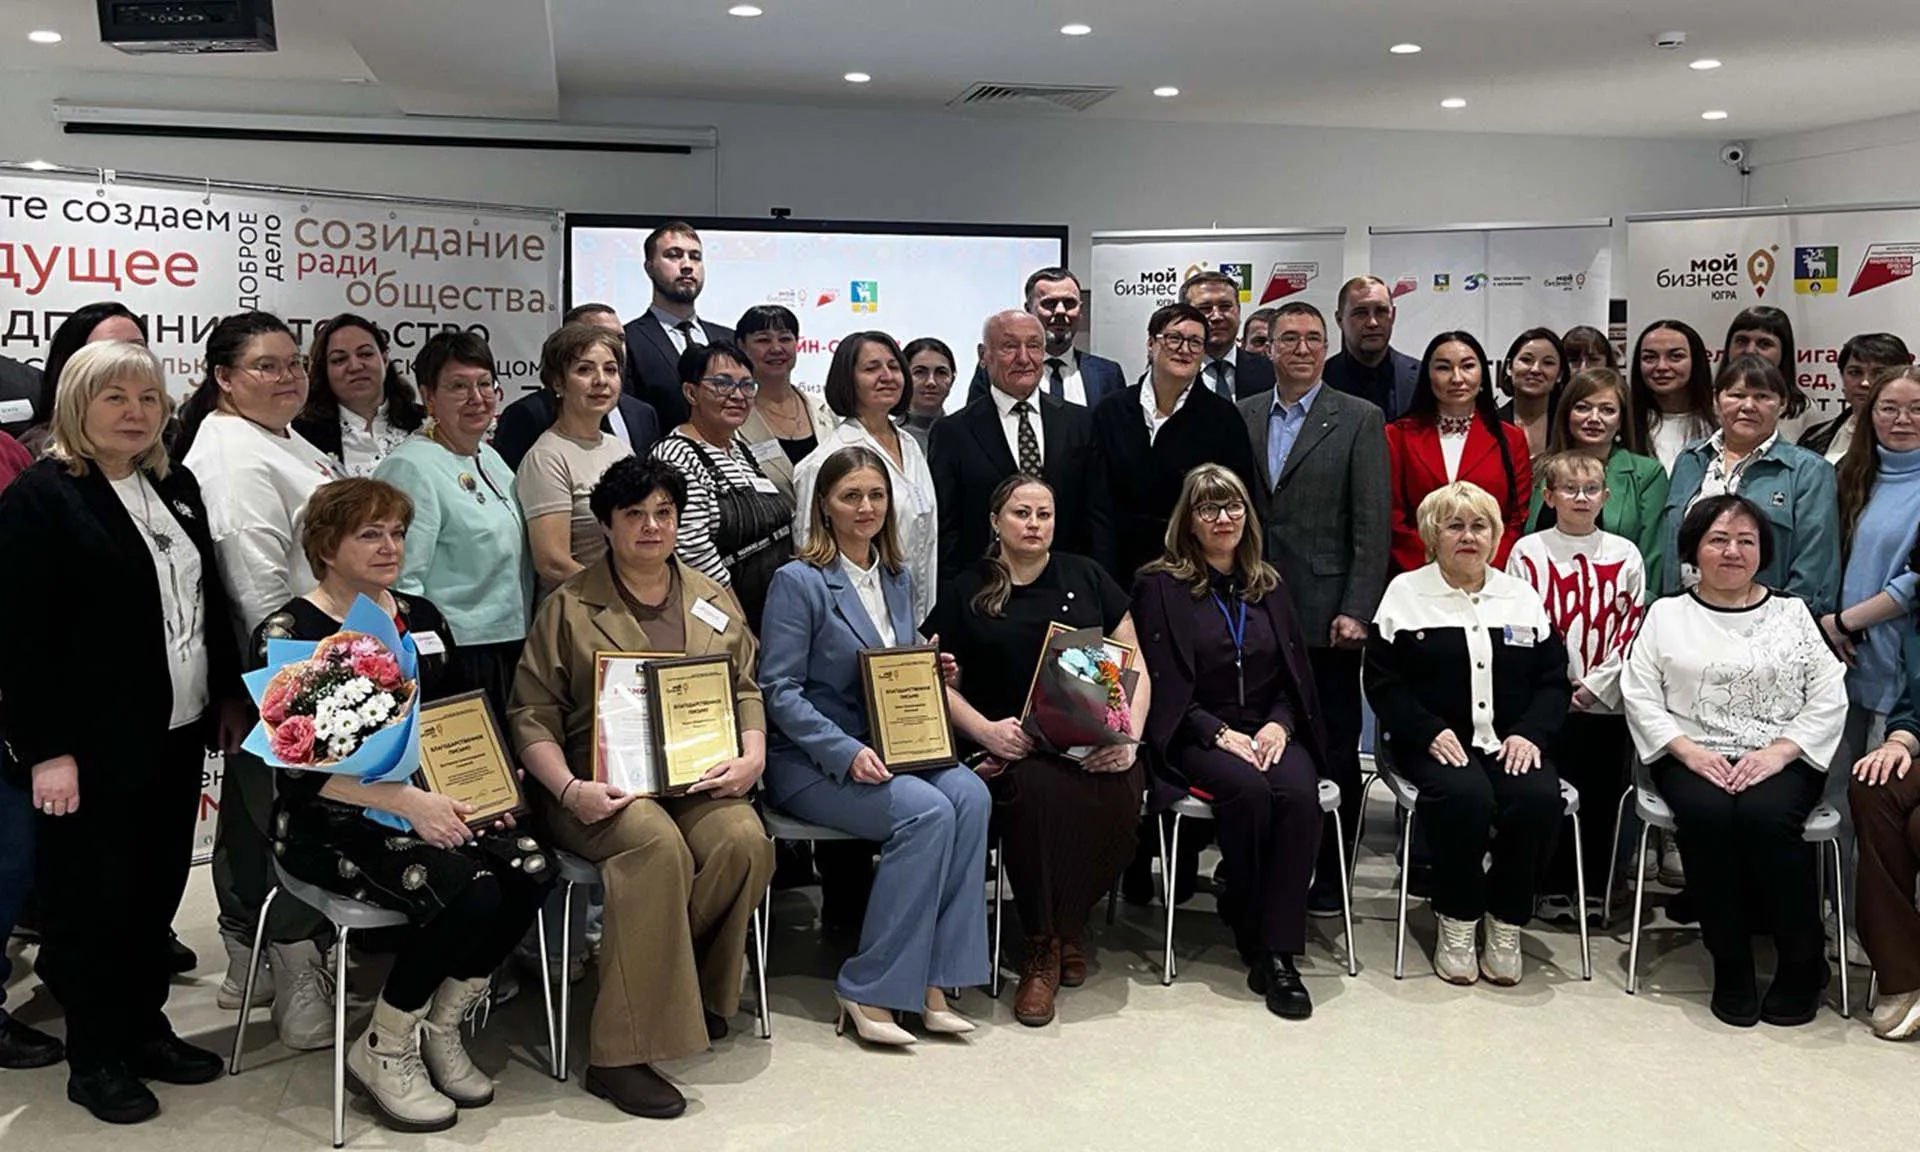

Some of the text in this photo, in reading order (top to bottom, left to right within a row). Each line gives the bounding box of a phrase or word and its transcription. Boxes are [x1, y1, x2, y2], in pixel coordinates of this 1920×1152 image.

[63, 199, 230, 232] создаем
[264, 214, 284, 282] дело
[294, 218, 545, 261] созидание
[238, 212, 260, 311] ДОБРОЕ
[297, 252, 377, 280] ради
[1140, 267, 1177, 283] мой
[1691, 253, 1738, 272] мой
[346, 270, 545, 314] общества
[1114, 279, 1177, 296] бизнес
[1656, 268, 1738, 288] бизнес
[1711, 290, 1737, 300] ЮГРА
